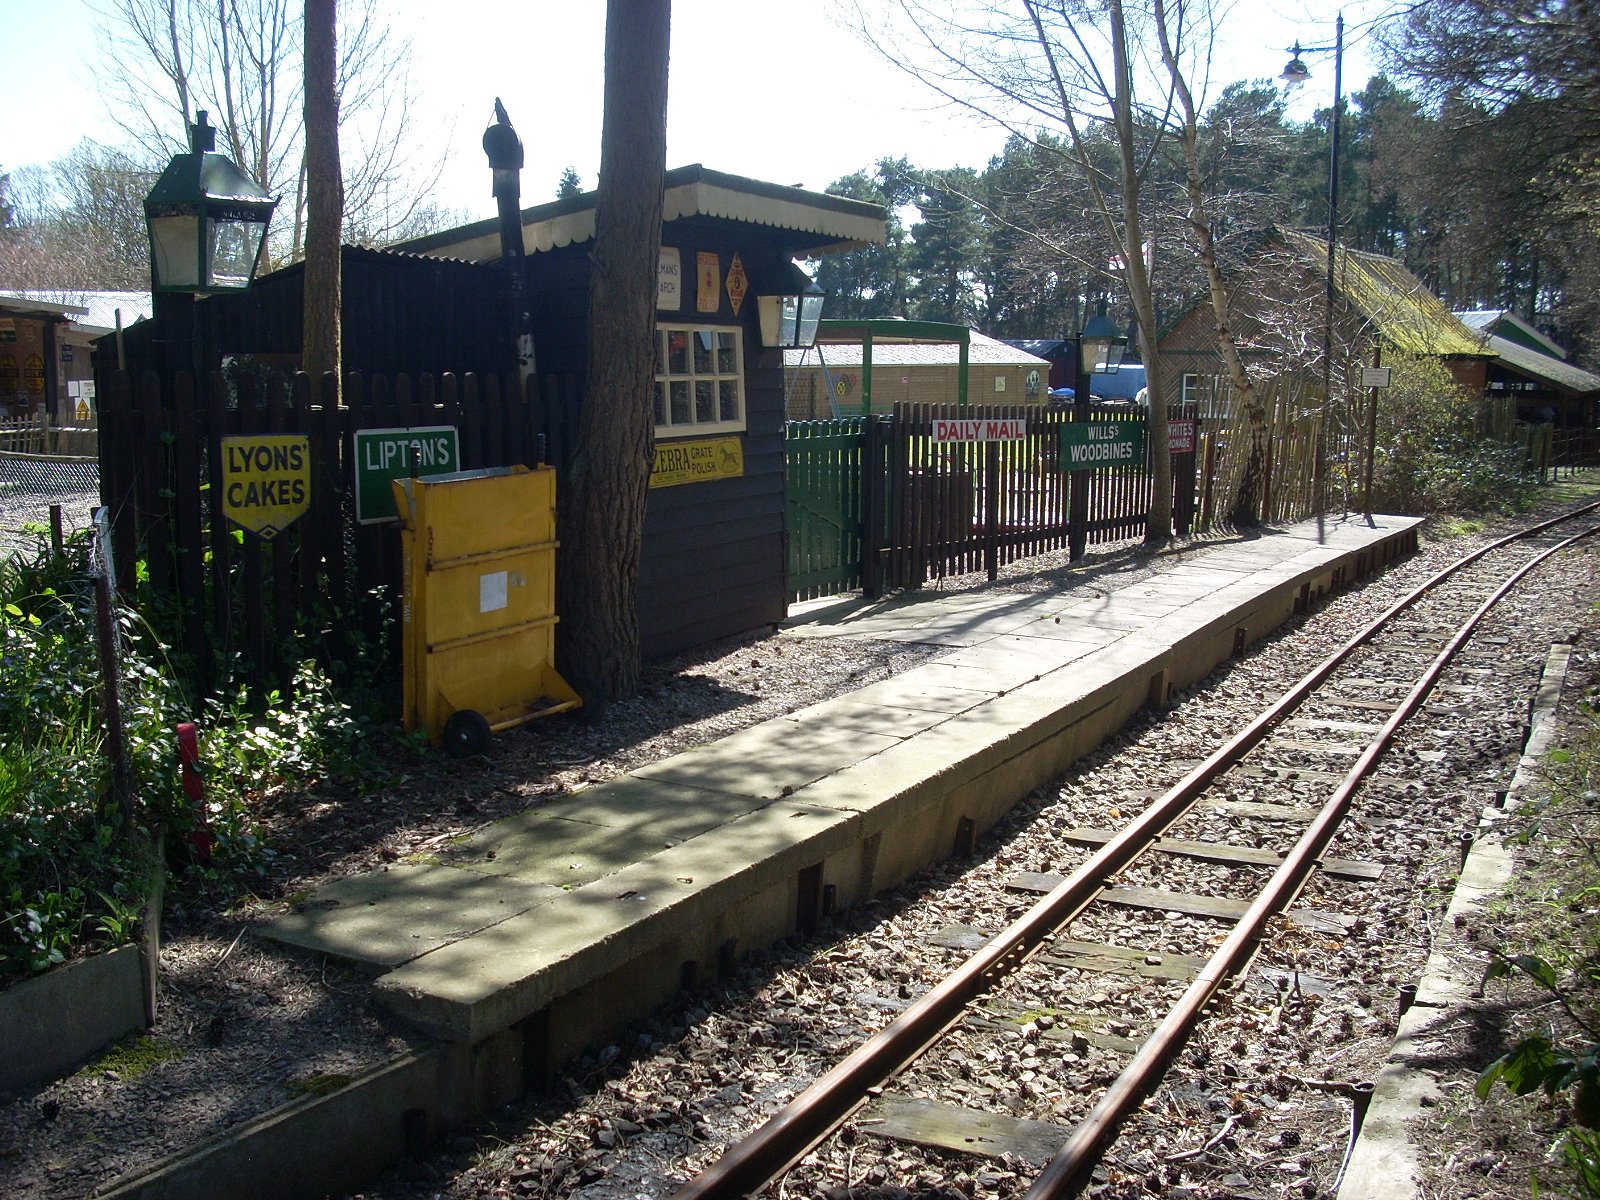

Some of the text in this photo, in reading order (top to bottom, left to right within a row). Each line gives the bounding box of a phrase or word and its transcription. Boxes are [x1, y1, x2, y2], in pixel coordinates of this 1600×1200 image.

[937, 420, 1023, 441] DAILY MAIL
[691, 447, 713, 459] GRATE
[1070, 442, 1133, 462] WOODBINES
[692, 462, 717, 476] POLISH
[227, 479, 305, 508] CAKES
